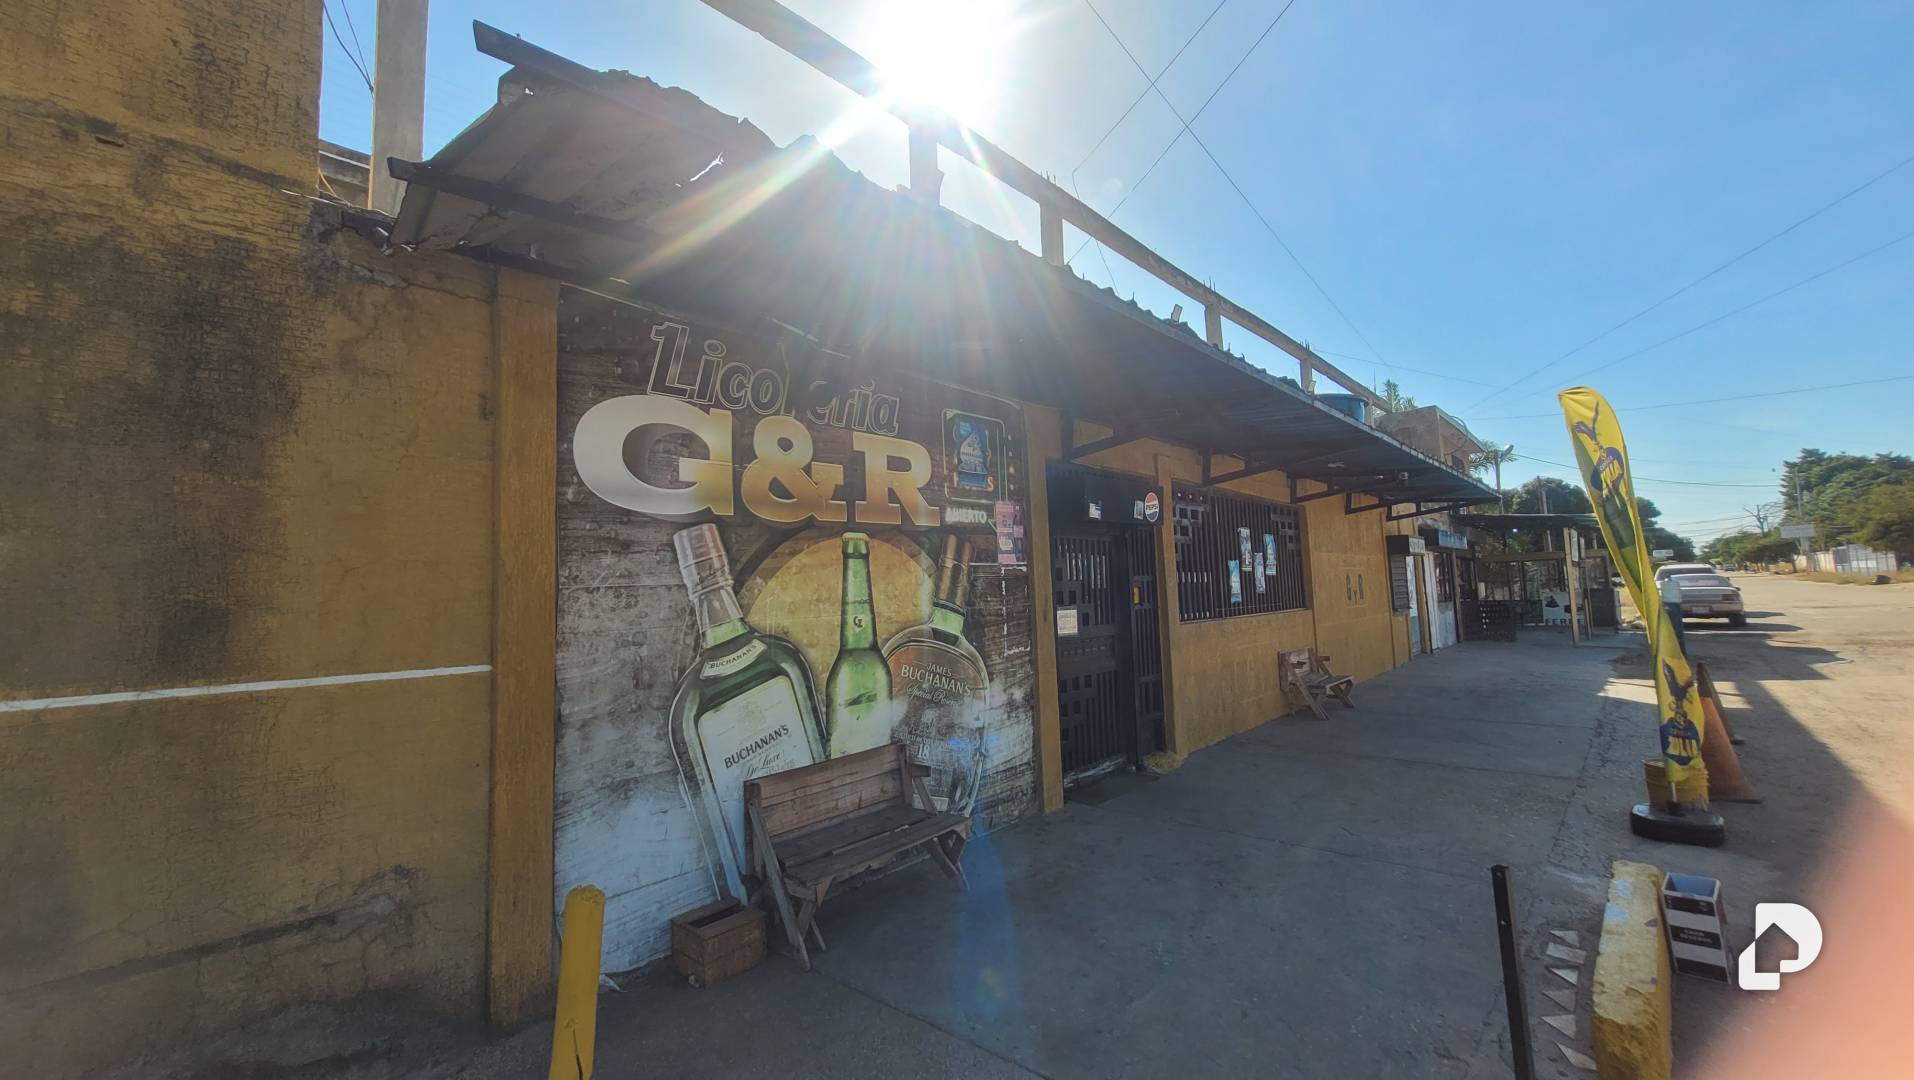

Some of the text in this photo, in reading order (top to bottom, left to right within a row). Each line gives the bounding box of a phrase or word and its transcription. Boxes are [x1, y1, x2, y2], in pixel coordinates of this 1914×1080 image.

[573, 394, 940, 527] G&R
[945, 507, 988, 524] ABIERTO
[926, 663, 952, 677] JAMES
[901, 664, 971, 697] BUCHANAN'S
[917, 743, 930, 759] 18
